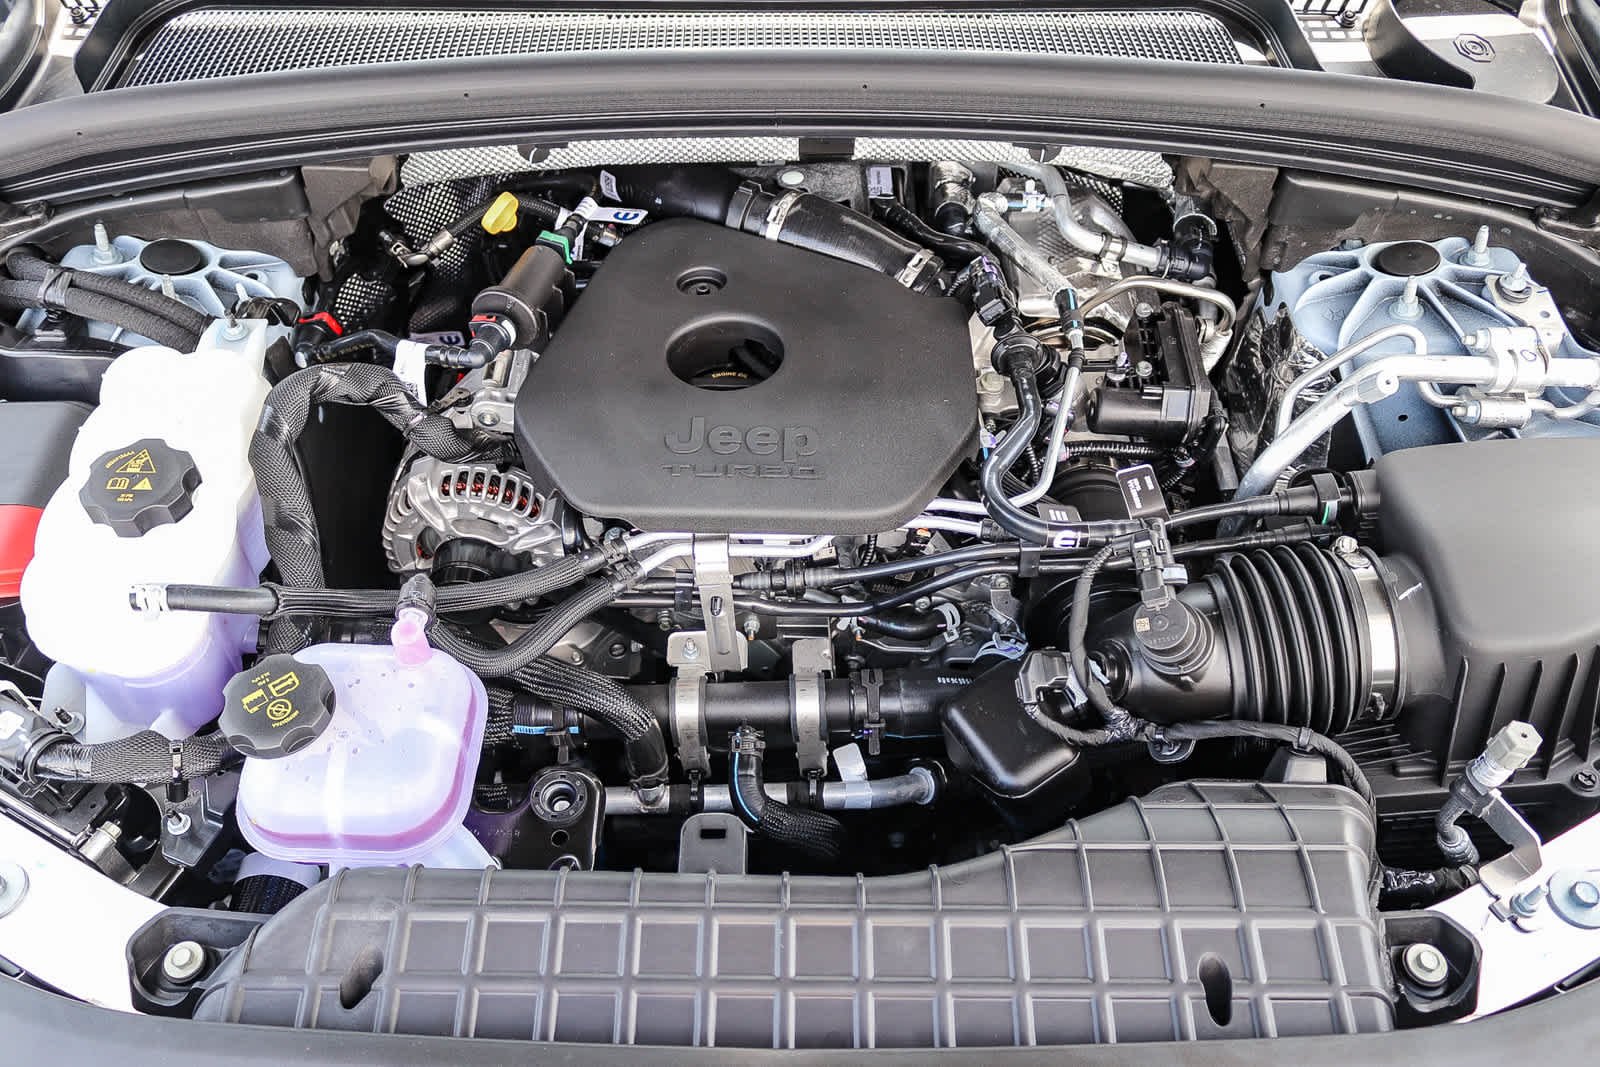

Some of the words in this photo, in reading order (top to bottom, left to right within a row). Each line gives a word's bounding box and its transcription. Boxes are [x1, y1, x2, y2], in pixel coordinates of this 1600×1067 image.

[711, 371, 737, 379] ENGINE
[663, 415, 819, 463] Jeep
[662, 464, 823, 480] TURBO
